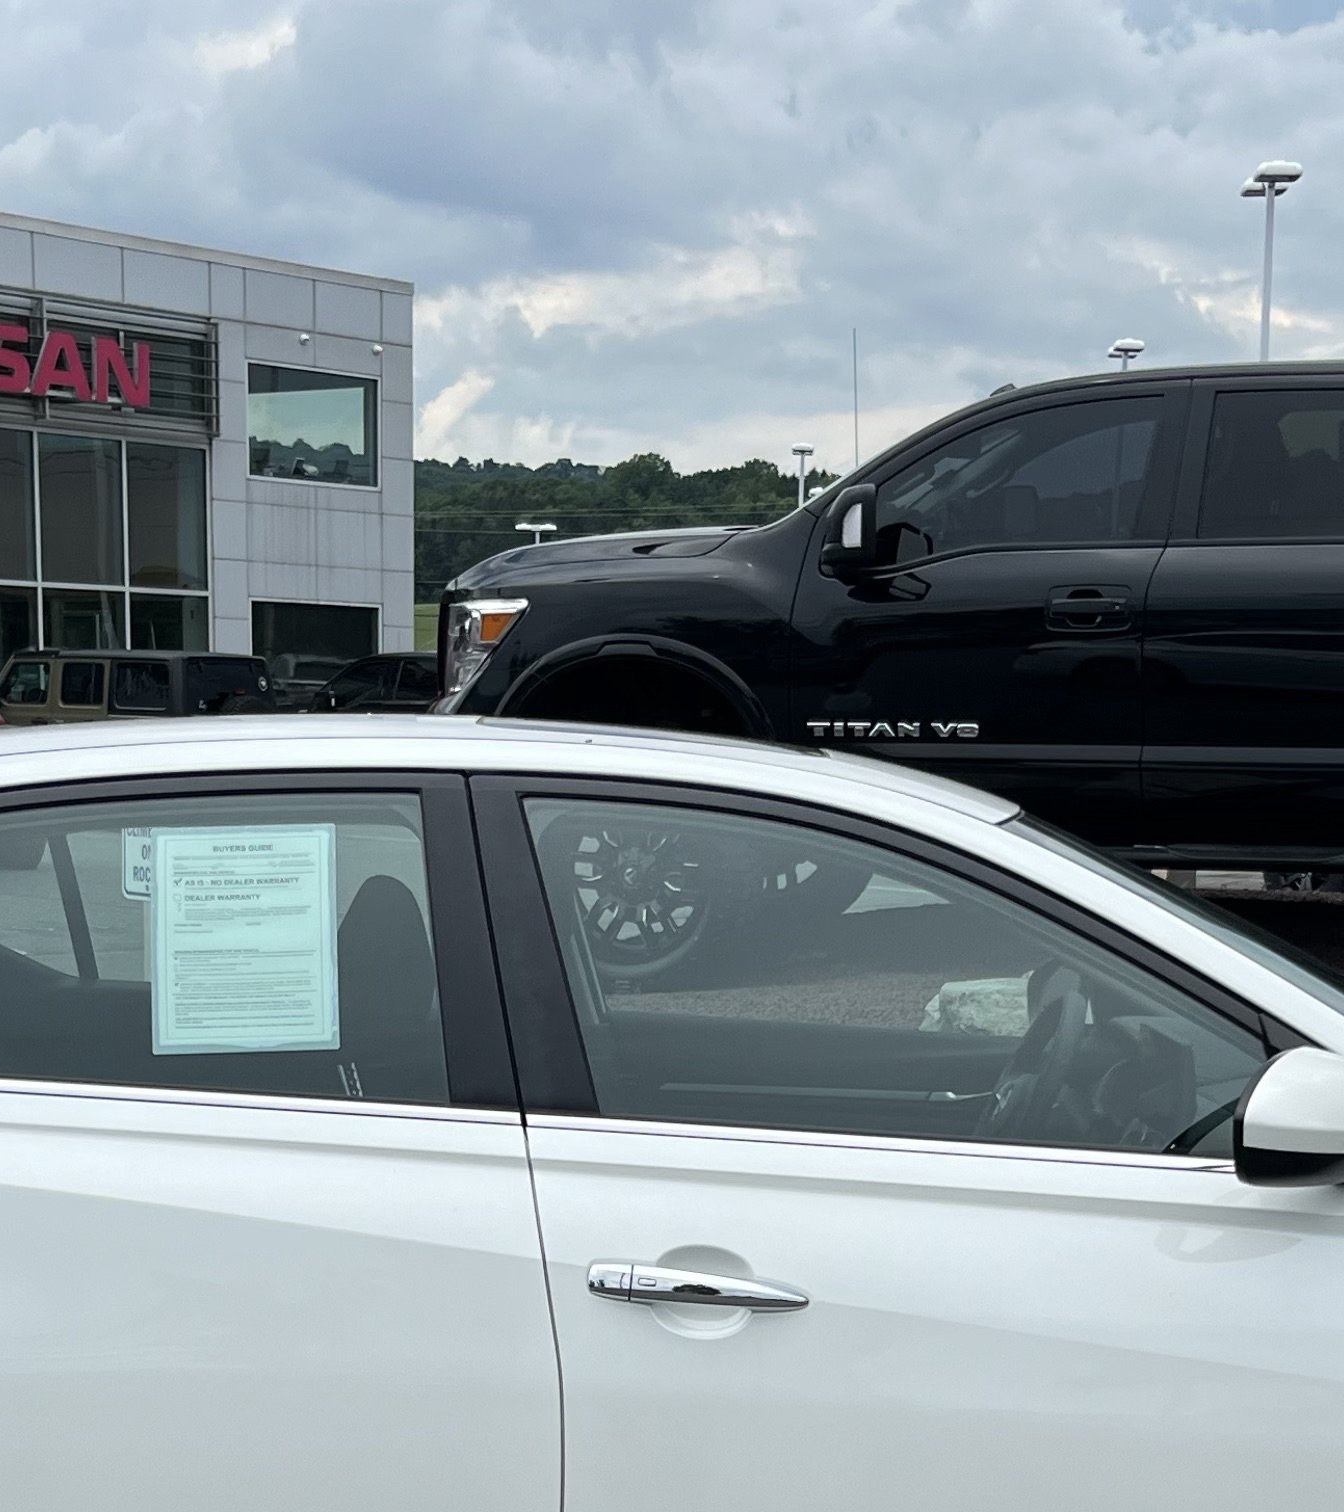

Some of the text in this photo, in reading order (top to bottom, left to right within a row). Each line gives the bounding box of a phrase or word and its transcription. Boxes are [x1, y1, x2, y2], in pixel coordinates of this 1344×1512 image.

[806, 721, 980, 738] TITAN V8
[224, 878, 255, 886] DEALER
[256, 877, 299, 885] WARRANTY
[217, 894, 261, 902] WARRANTY
